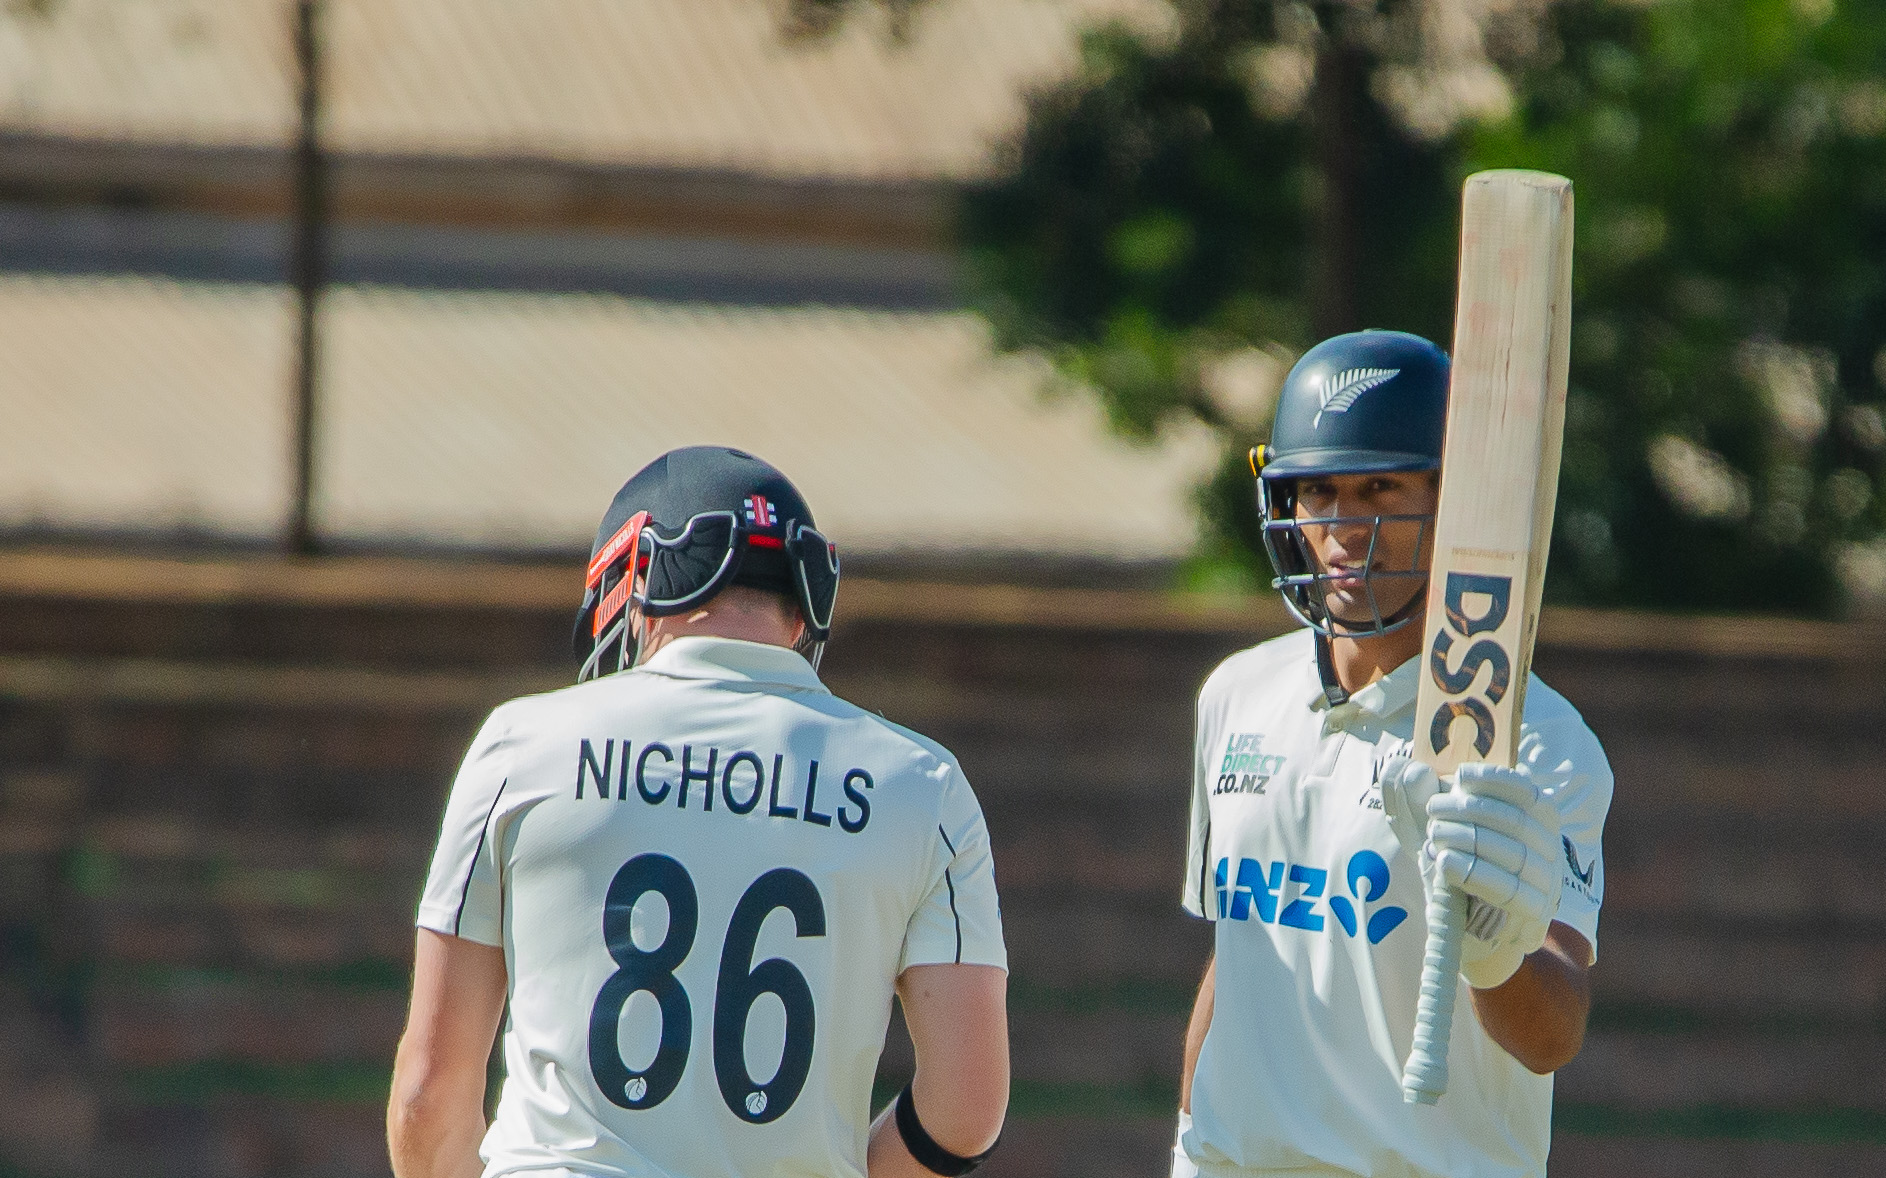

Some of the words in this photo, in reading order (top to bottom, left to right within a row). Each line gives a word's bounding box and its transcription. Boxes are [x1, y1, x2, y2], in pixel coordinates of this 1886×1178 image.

[1430, 570, 1513, 759] DSC
[1221, 752, 1287, 775] DIRECT
[1227, 732, 1265, 753] LIFE
[575, 738, 874, 834] NICHOLLS
[1213, 773, 1270, 796] .CO.NZ
[588, 853, 827, 1124] 86
